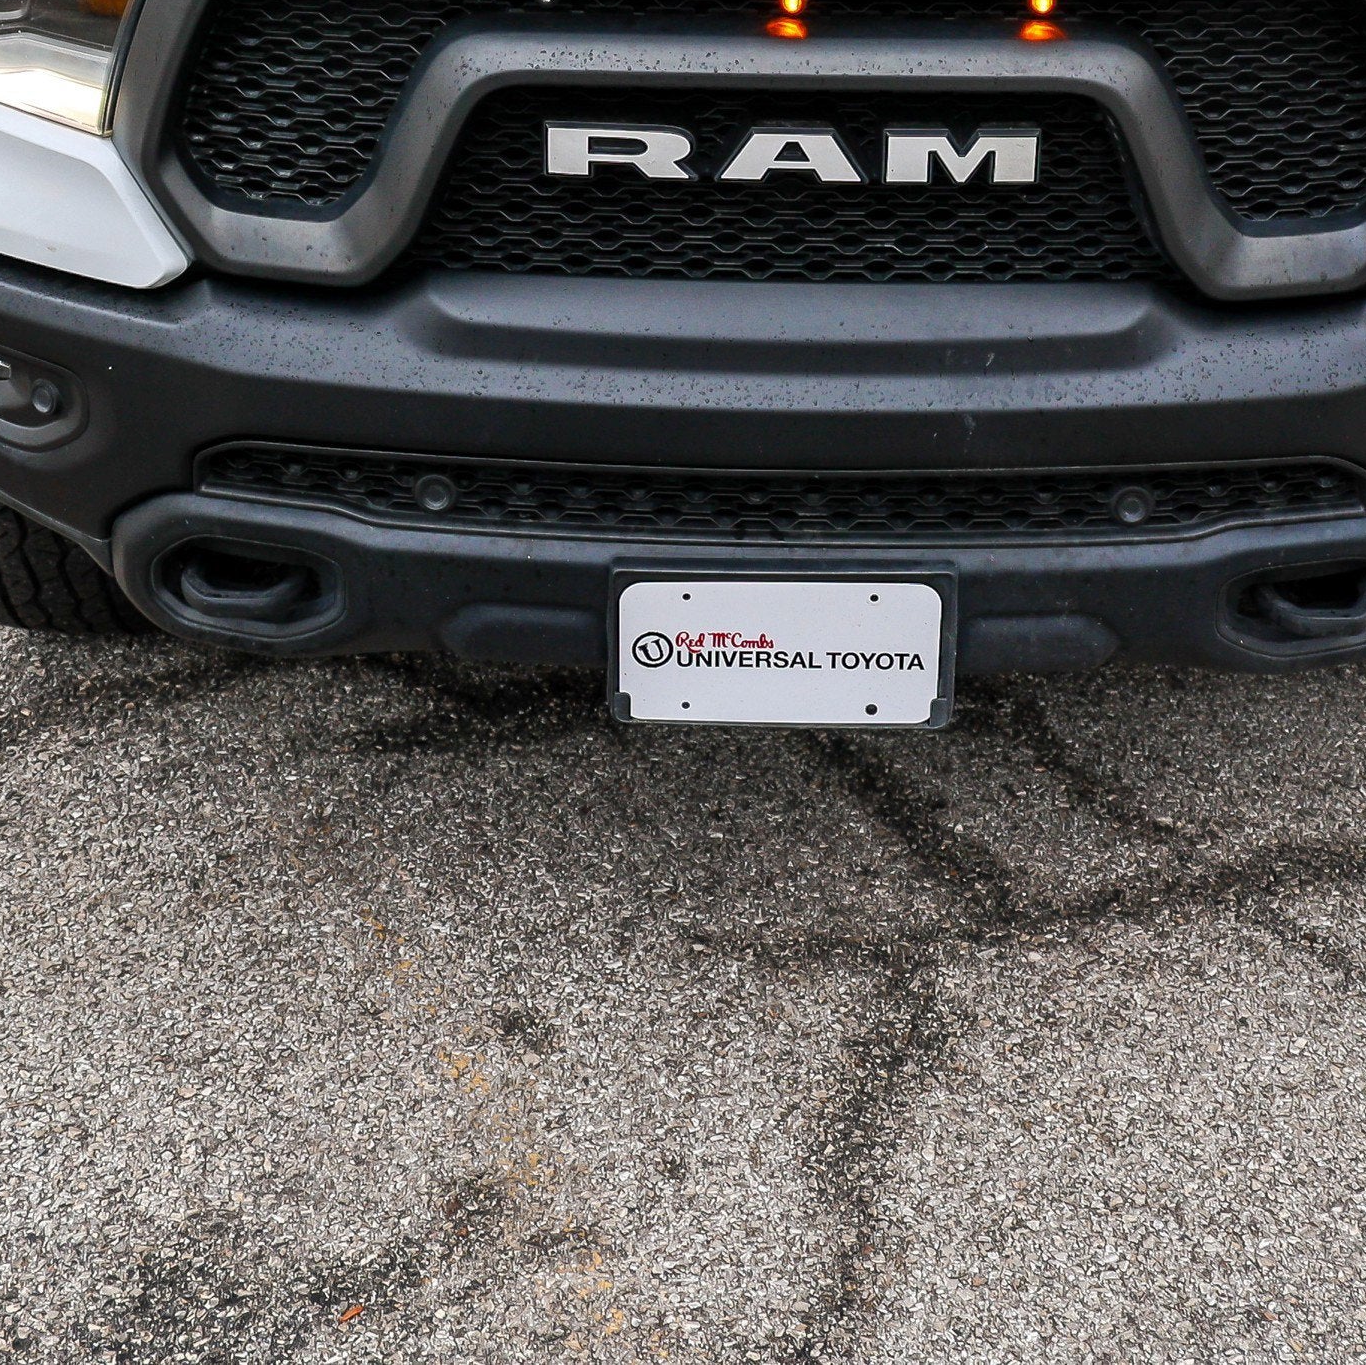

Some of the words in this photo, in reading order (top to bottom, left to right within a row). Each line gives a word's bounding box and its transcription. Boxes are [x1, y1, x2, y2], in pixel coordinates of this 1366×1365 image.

[545, 123, 1038, 184] RAM
[676, 631, 705, 654] Red
[708, 632, 774, 649] McCombs
[677, 651, 822, 669] UNIVERSAL
[826, 652, 925, 671] TOYOTA
